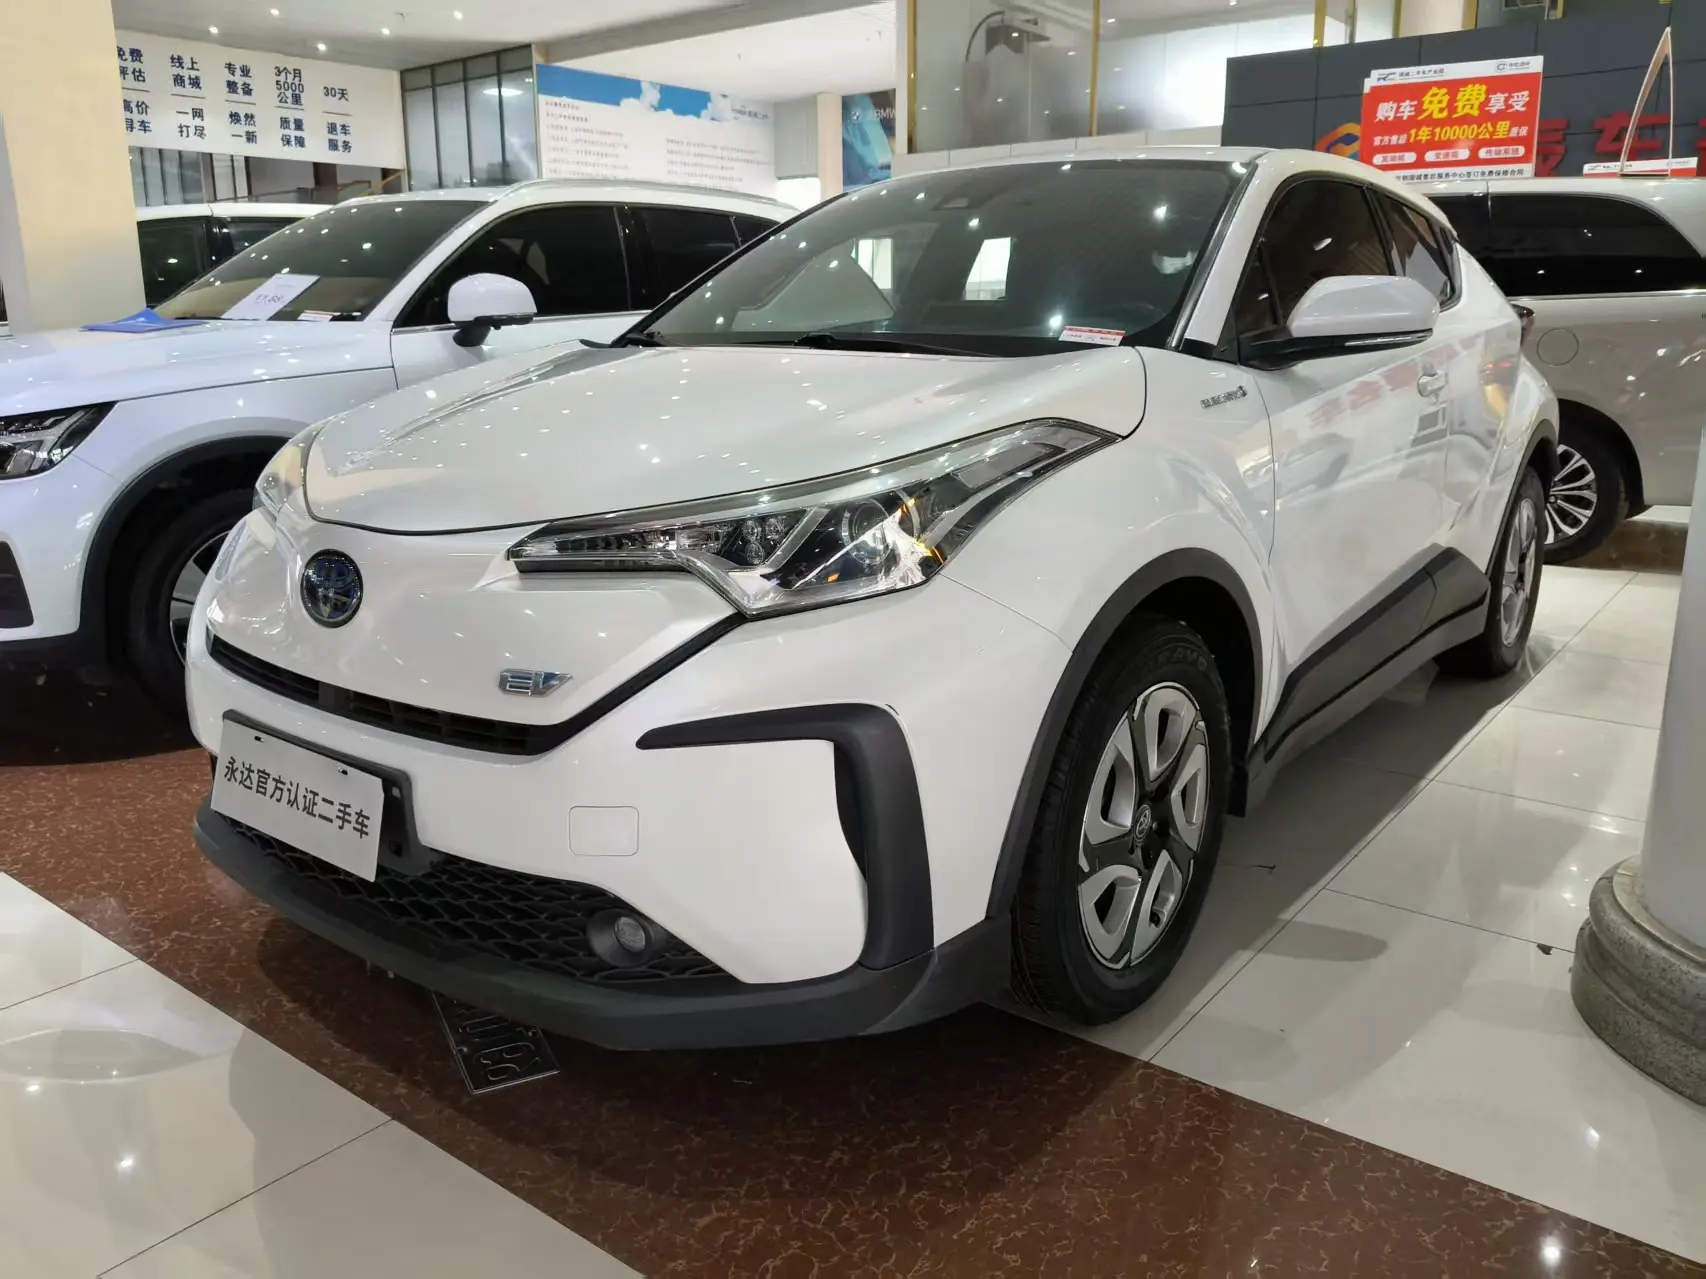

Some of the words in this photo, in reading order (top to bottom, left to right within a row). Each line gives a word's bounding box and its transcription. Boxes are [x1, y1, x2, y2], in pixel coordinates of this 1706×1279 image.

[117, 46, 143, 64] 免费
[170, 54, 200, 72] 线上
[224, 62, 252, 78] 专业
[274, 66, 302, 82] 3个月
[172, 73, 202, 90] 商城
[226, 80, 253, 96] 整备
[275, 80, 305, 93] 5000
[277, 92, 303, 106] 公里
[323, 86, 349, 102] 30天
[123, 99, 150, 116] 高价
[1374, 84, 1530, 122] 购车免费享受
[176, 107, 204, 121] 一网
[229, 111, 256, 127] 焕然
[178, 123, 207, 140] 打尽
[279, 117, 305, 132] 质量
[327, 122, 351, 136] 退车
[231, 131, 257, 144] 一新
[280, 134, 306, 148] 保障
[328, 138, 352, 153] 服务
[500, 669, 573, 697] EV
[224, 756, 371, 839] 永达官方认证二手车
